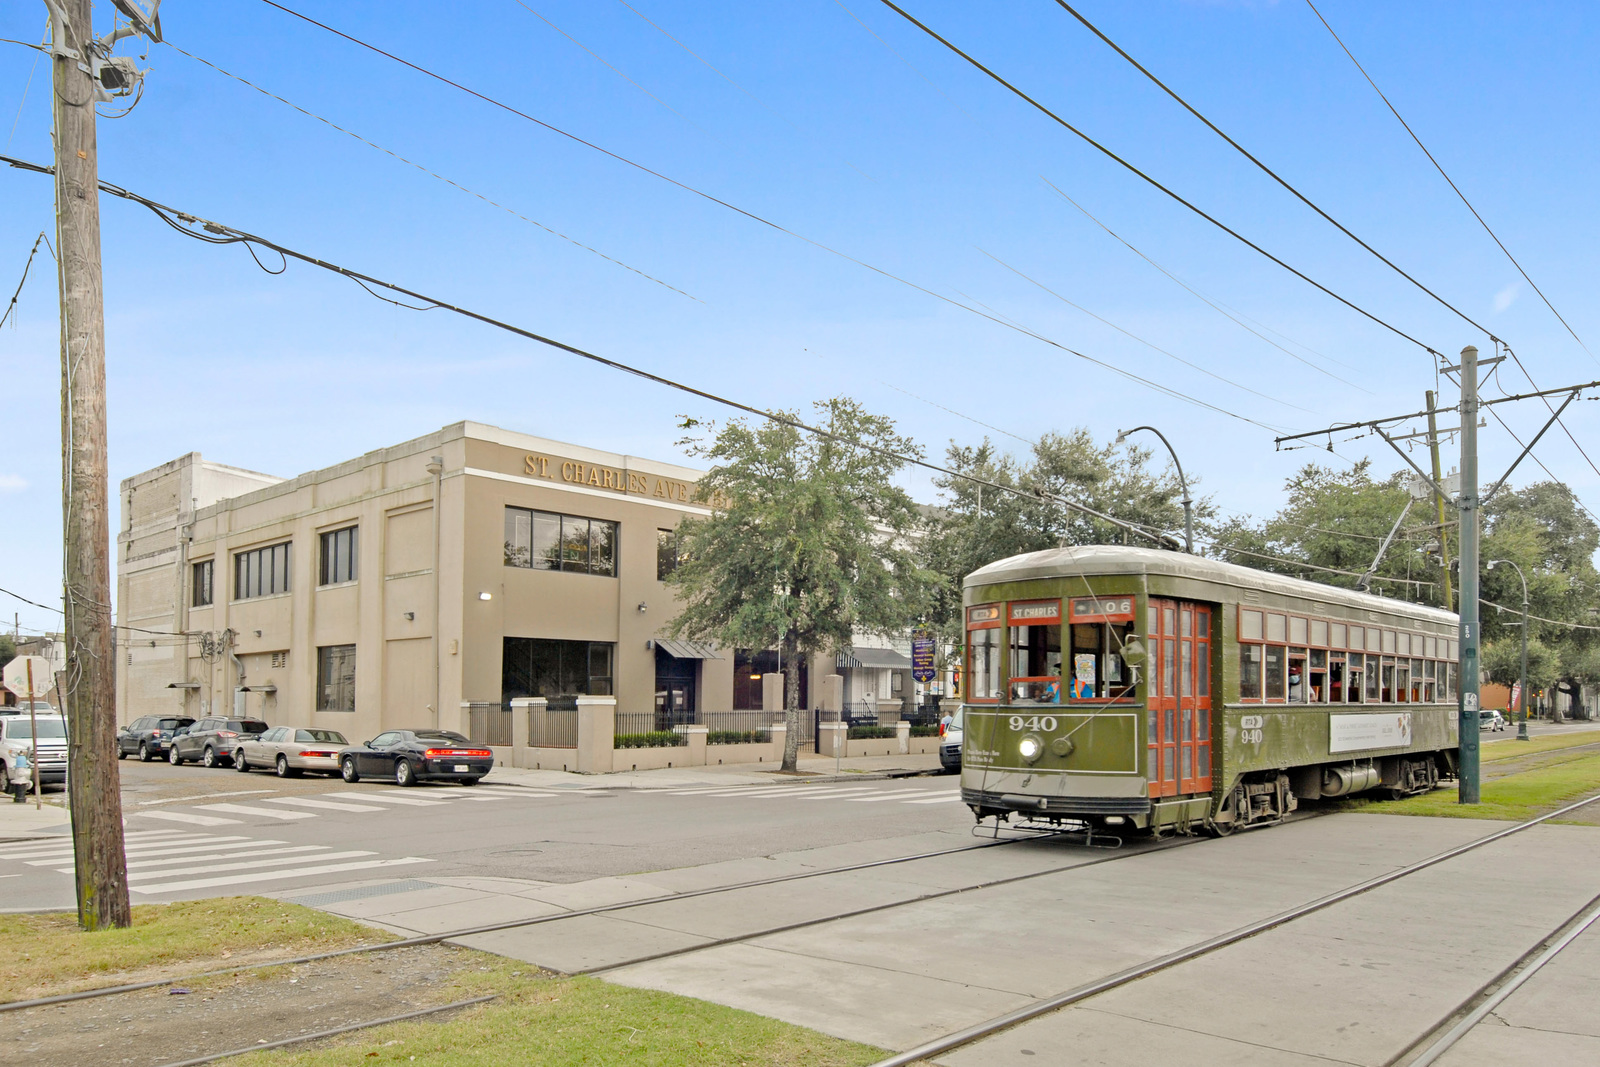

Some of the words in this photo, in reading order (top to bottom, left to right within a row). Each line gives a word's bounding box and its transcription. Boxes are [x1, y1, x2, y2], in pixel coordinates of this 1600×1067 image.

[525, 454, 554, 478] ST.
[562, 461, 647, 494] CHARLES
[653, 479, 687, 501] AVE
[1024, 607, 1057, 618] CHARLES
[1009, 716, 1057, 731] 940
[1241, 729, 1263, 744] 940
